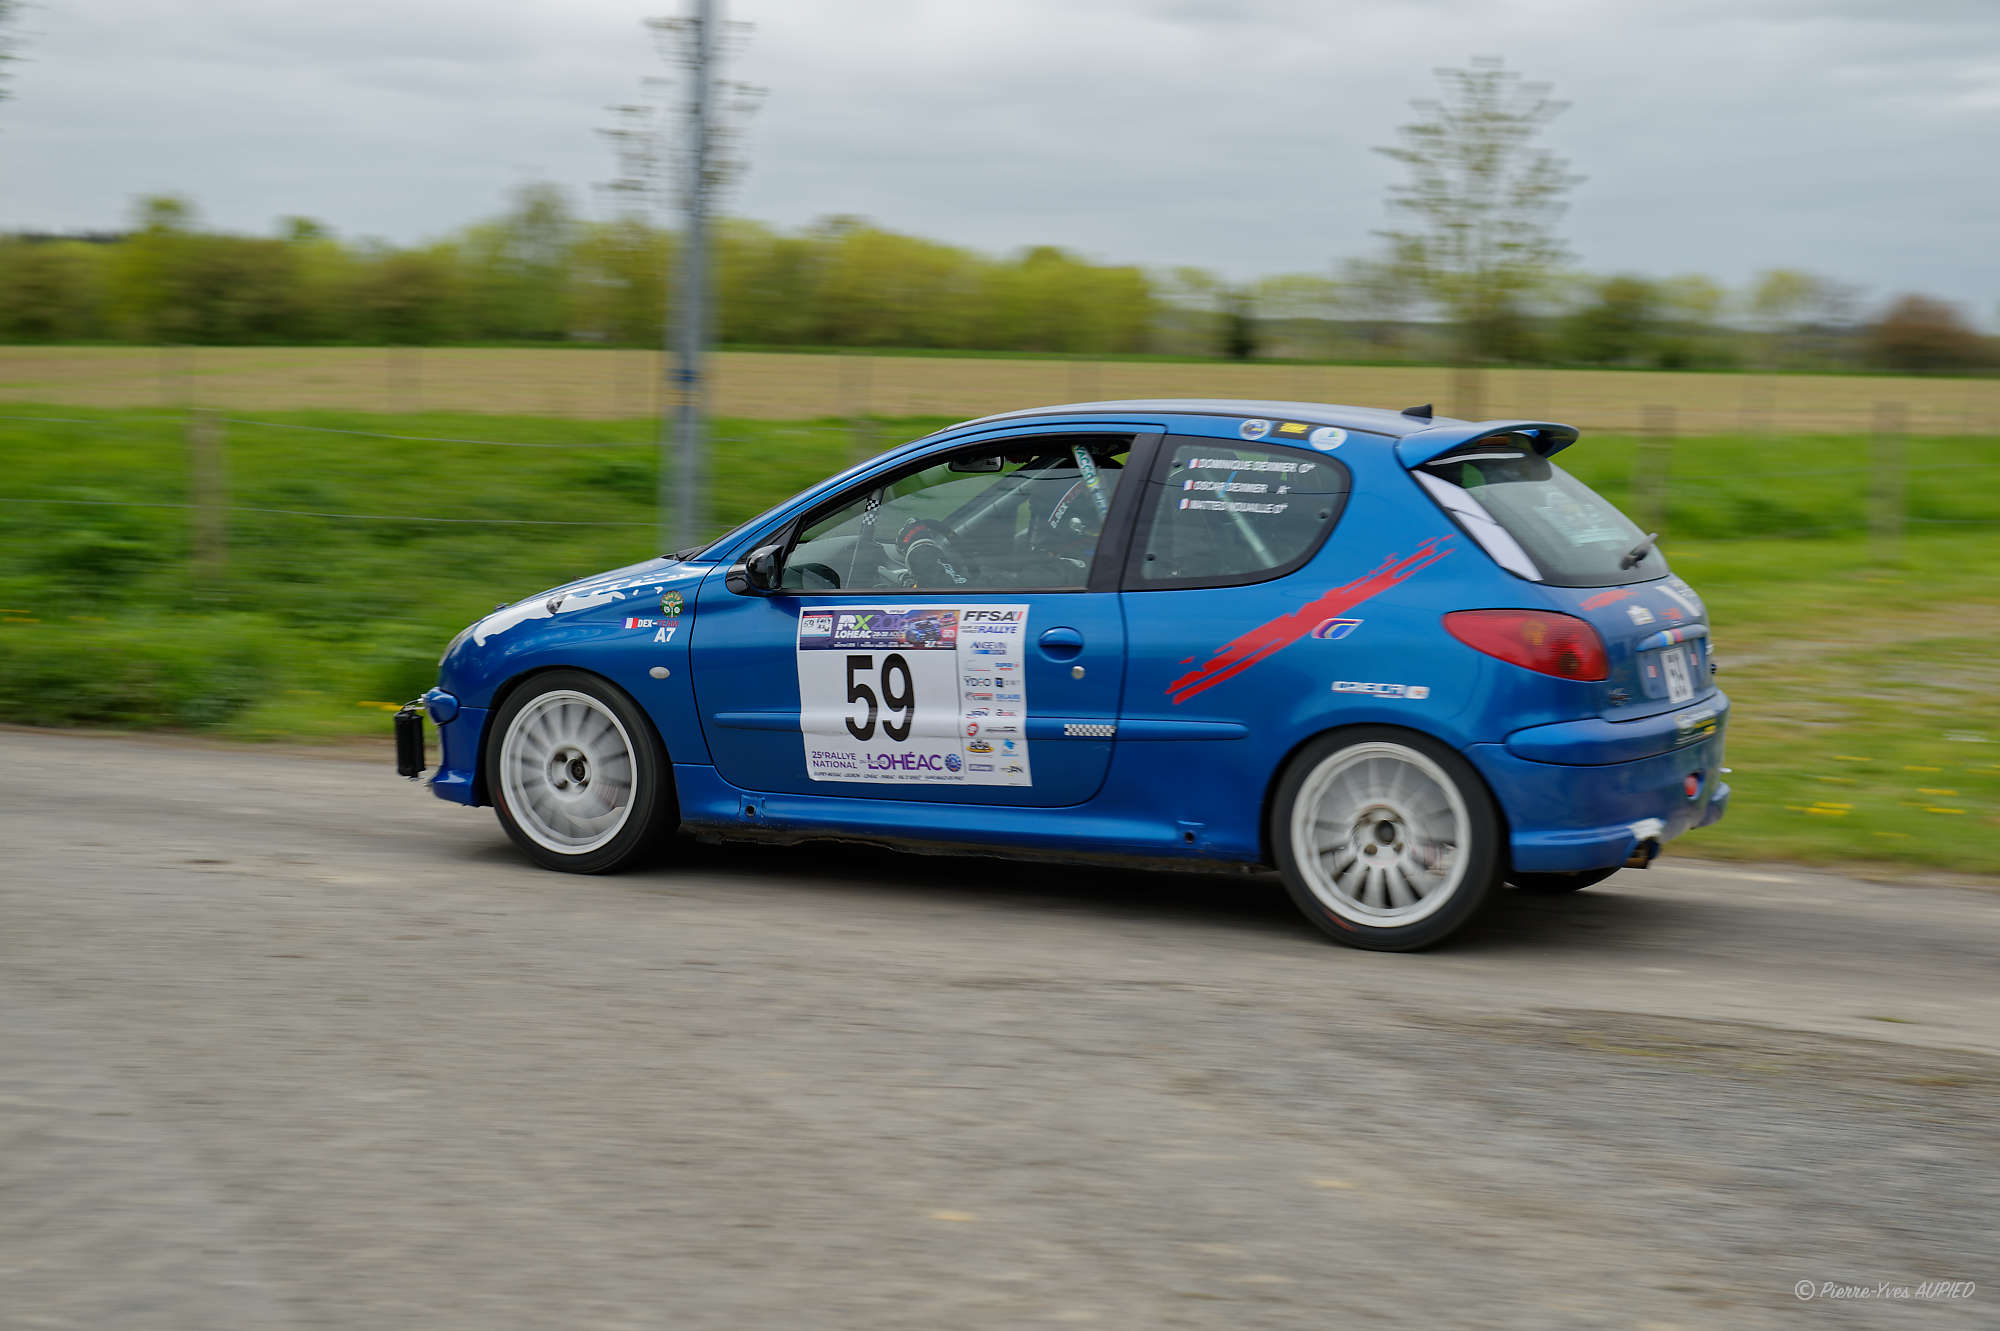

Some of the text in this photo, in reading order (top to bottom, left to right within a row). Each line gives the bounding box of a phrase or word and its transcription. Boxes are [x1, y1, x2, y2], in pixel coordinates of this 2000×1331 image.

[963, 610, 1015, 622] FFSA
[834, 630, 873, 639] LOHEAC
[977, 625, 1018, 634] RALLYE
[653, 627, 676, 643] A7
[845, 652, 915, 742] 59
[825, 751, 857, 760] RALLYE
[812, 760, 858, 769] NATIONAL
[866, 751, 944, 771] LOHÉAC
